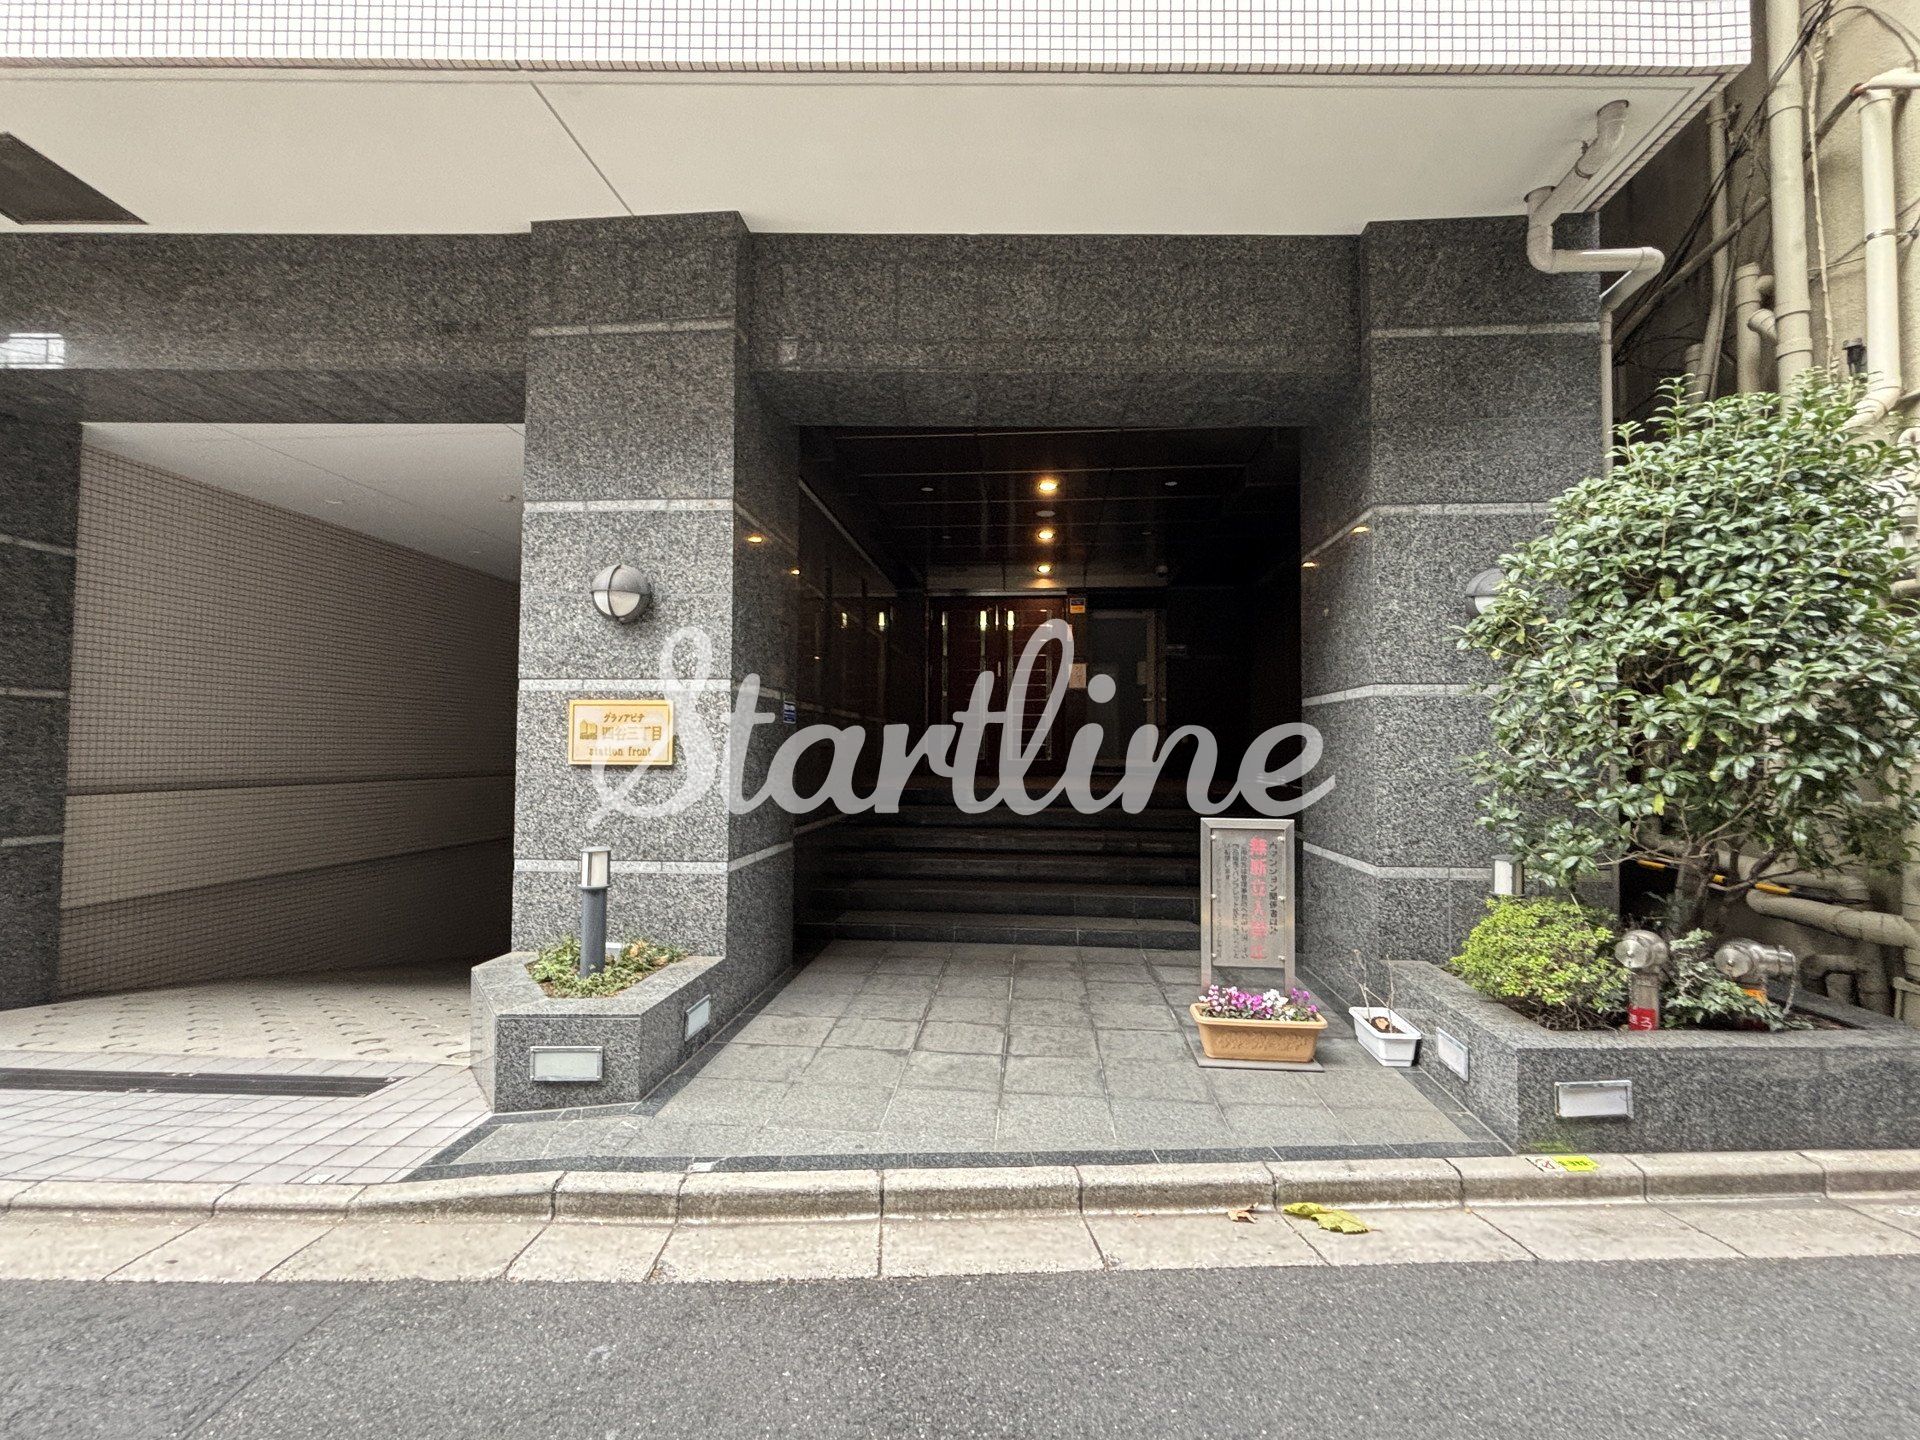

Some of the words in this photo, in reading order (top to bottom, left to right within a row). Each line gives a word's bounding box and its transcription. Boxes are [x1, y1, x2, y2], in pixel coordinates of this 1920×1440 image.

[602, 726, 662, 741] 四谷三丁目
[588, 746, 624, 757] station
[628, 745, 652, 757] front
